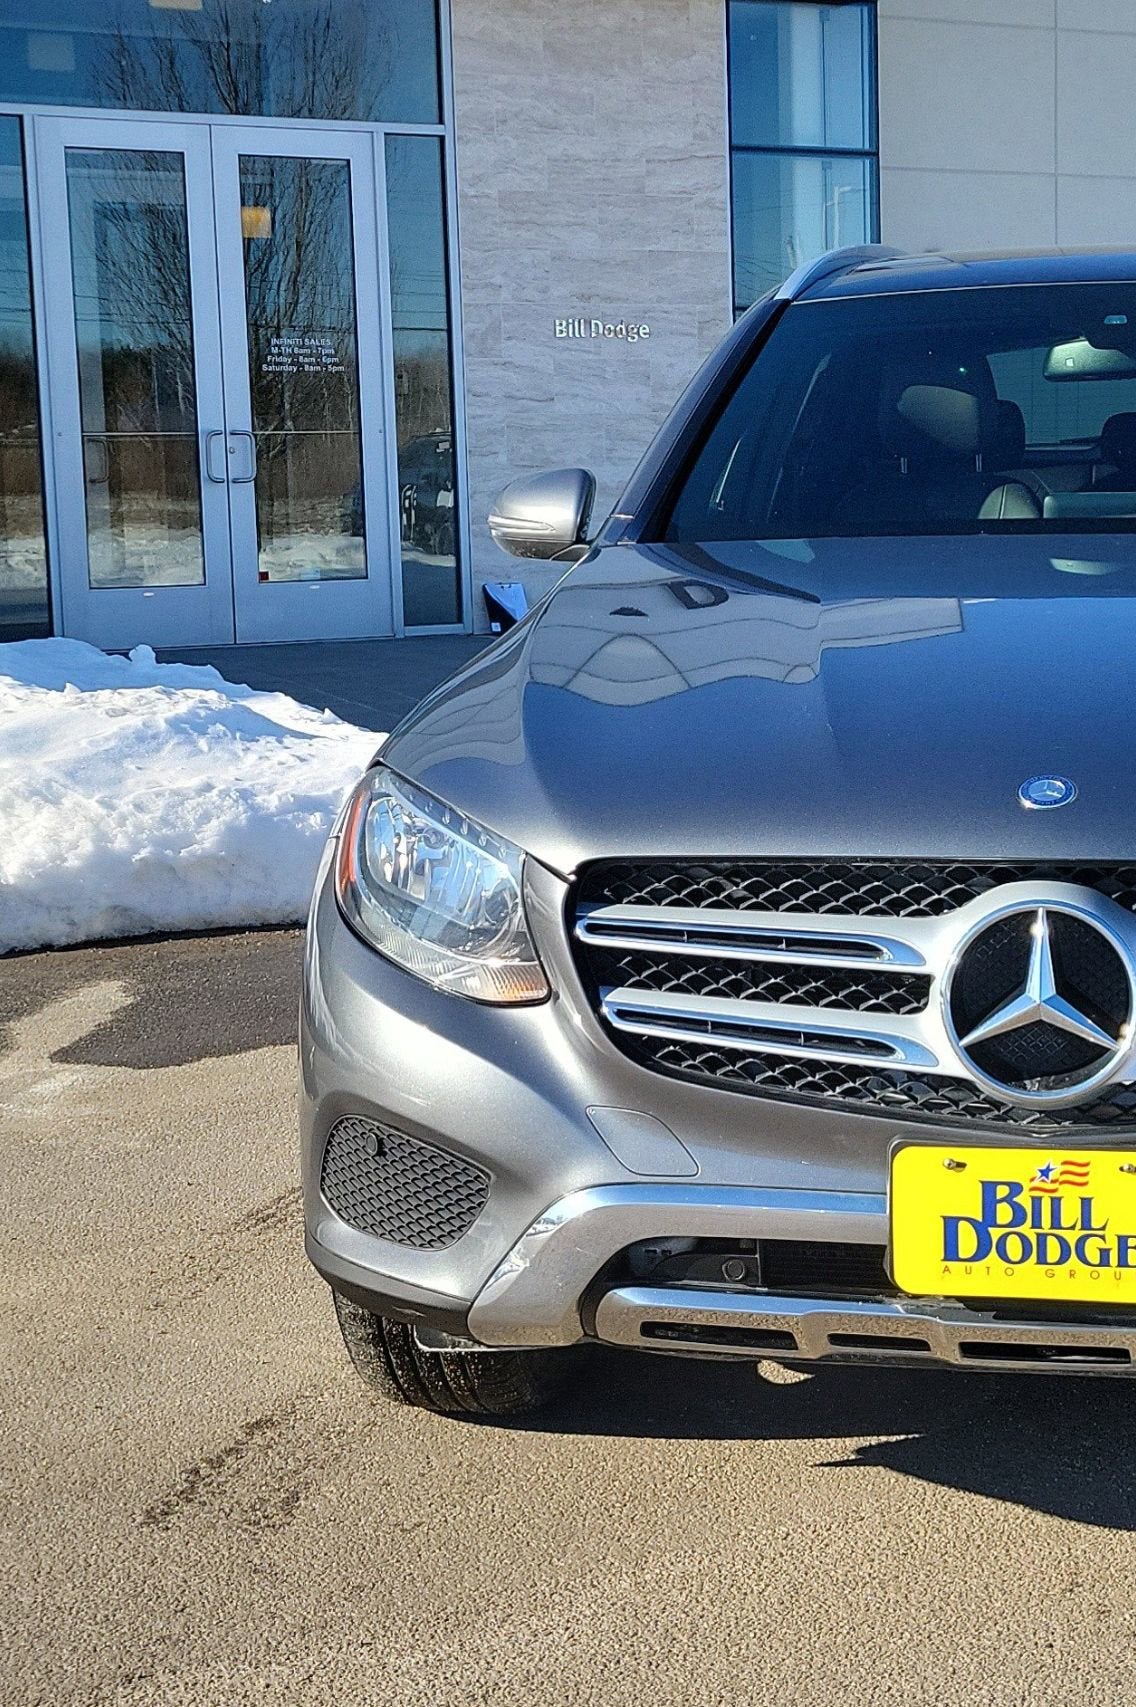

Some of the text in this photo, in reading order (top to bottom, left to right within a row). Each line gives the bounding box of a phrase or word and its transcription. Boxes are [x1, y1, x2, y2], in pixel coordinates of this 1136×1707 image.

[554, 318, 650, 342] Bill Dodge
[271, 338, 331, 346] INFINITI SALES
[267, 355, 293, 364] Friday
[262, 364, 298, 373] Saturday
[979, 1179, 1109, 1231] BILL
[942, 1265, 1015, 1277] AUTO
